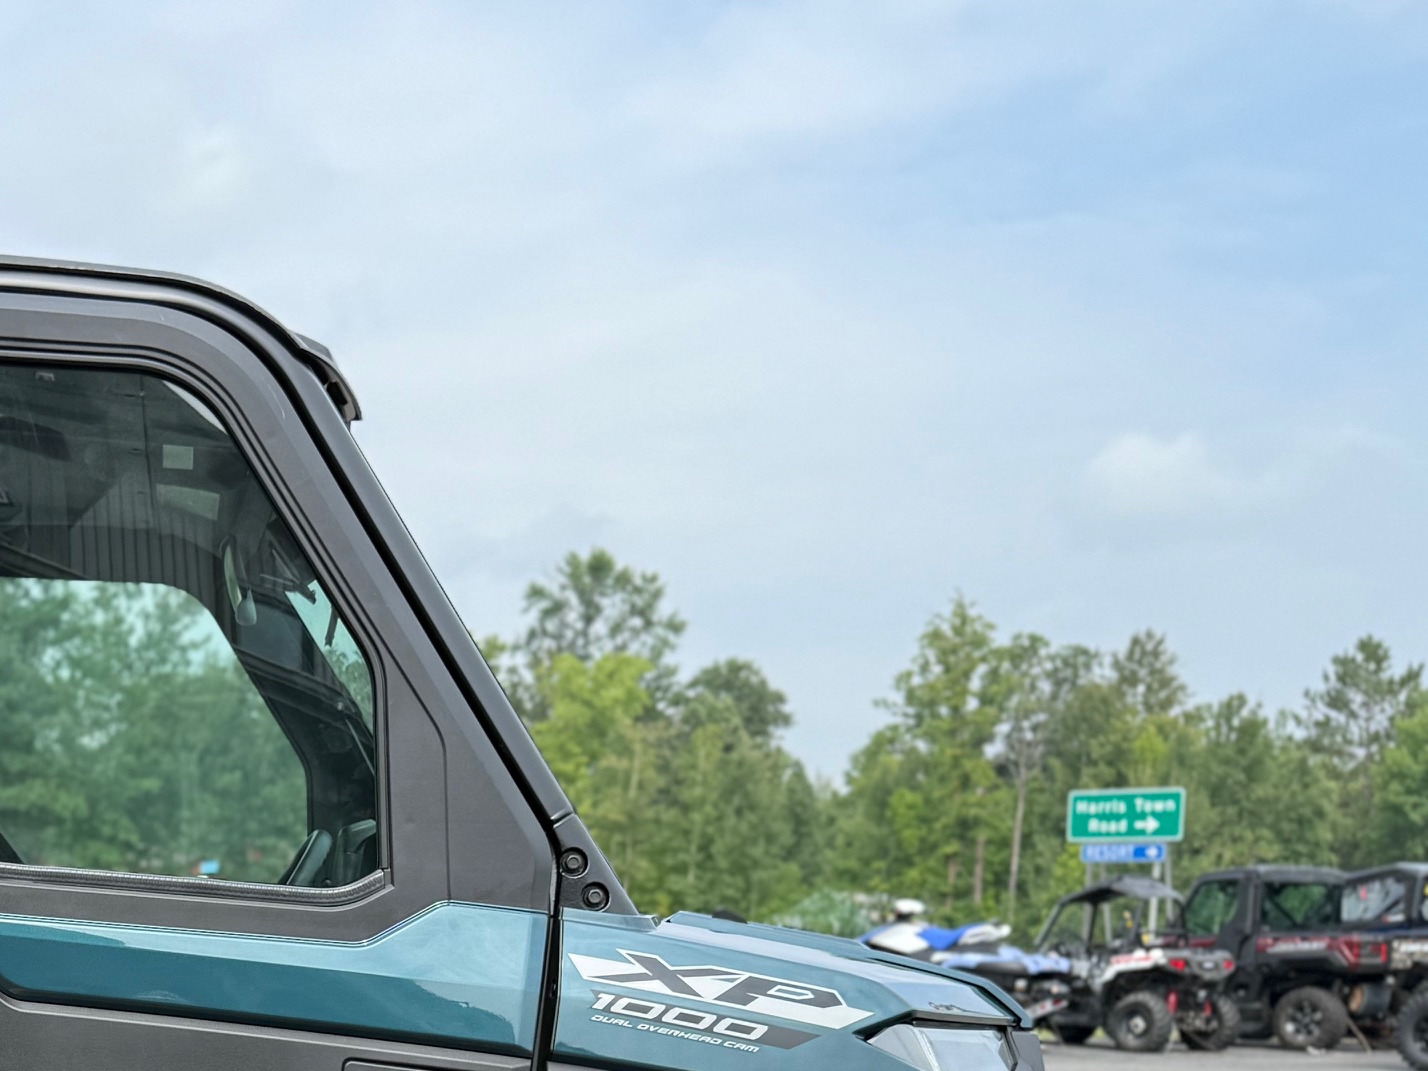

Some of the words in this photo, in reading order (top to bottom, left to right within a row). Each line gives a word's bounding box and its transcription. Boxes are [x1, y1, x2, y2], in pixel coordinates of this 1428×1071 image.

[1075, 800, 1127, 815] Harris
[1134, 797, 1177, 813] Town
[1087, 818, 1128, 834] Road
[582, 948, 852, 1010] XP
[589, 1013, 634, 1029] DUAL
[636, 1022, 723, 1046] OVERHEAD
[722, 1040, 761, 1054] CAM
[591, 992, 770, 1041] 1000
